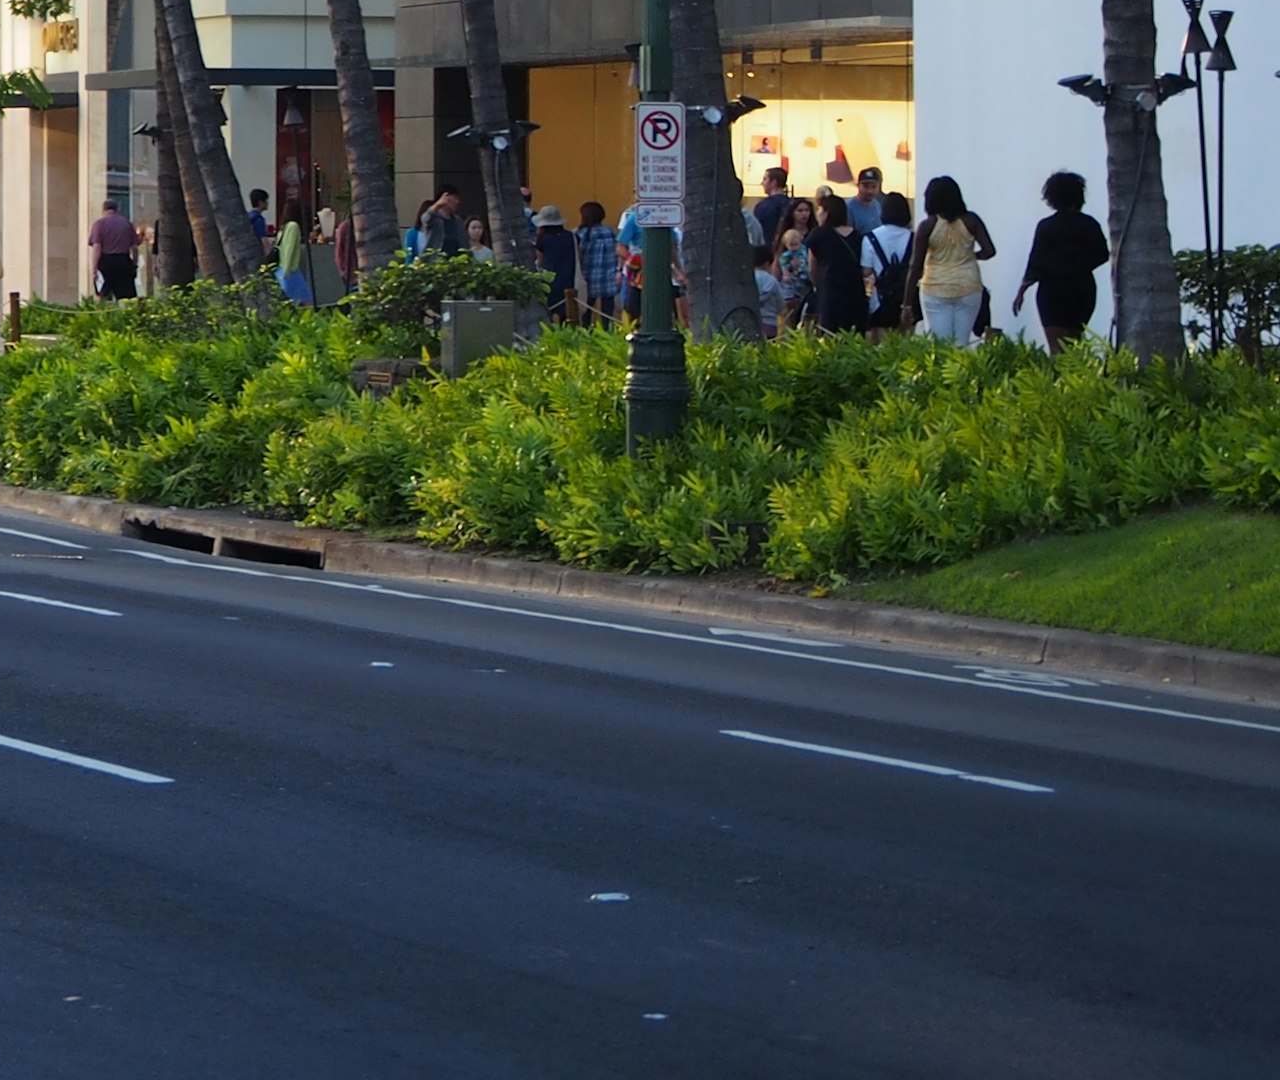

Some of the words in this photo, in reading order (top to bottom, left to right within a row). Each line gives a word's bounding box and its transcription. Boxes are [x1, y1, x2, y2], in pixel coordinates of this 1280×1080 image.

[642, 155, 650, 163] NO
[652, 155, 678, 163] STOPPING
[642, 165, 650, 173] NO
[652, 165, 678, 173] STANDING
[643, 175, 651, 183] NO
[639, 184, 647, 192] NO
